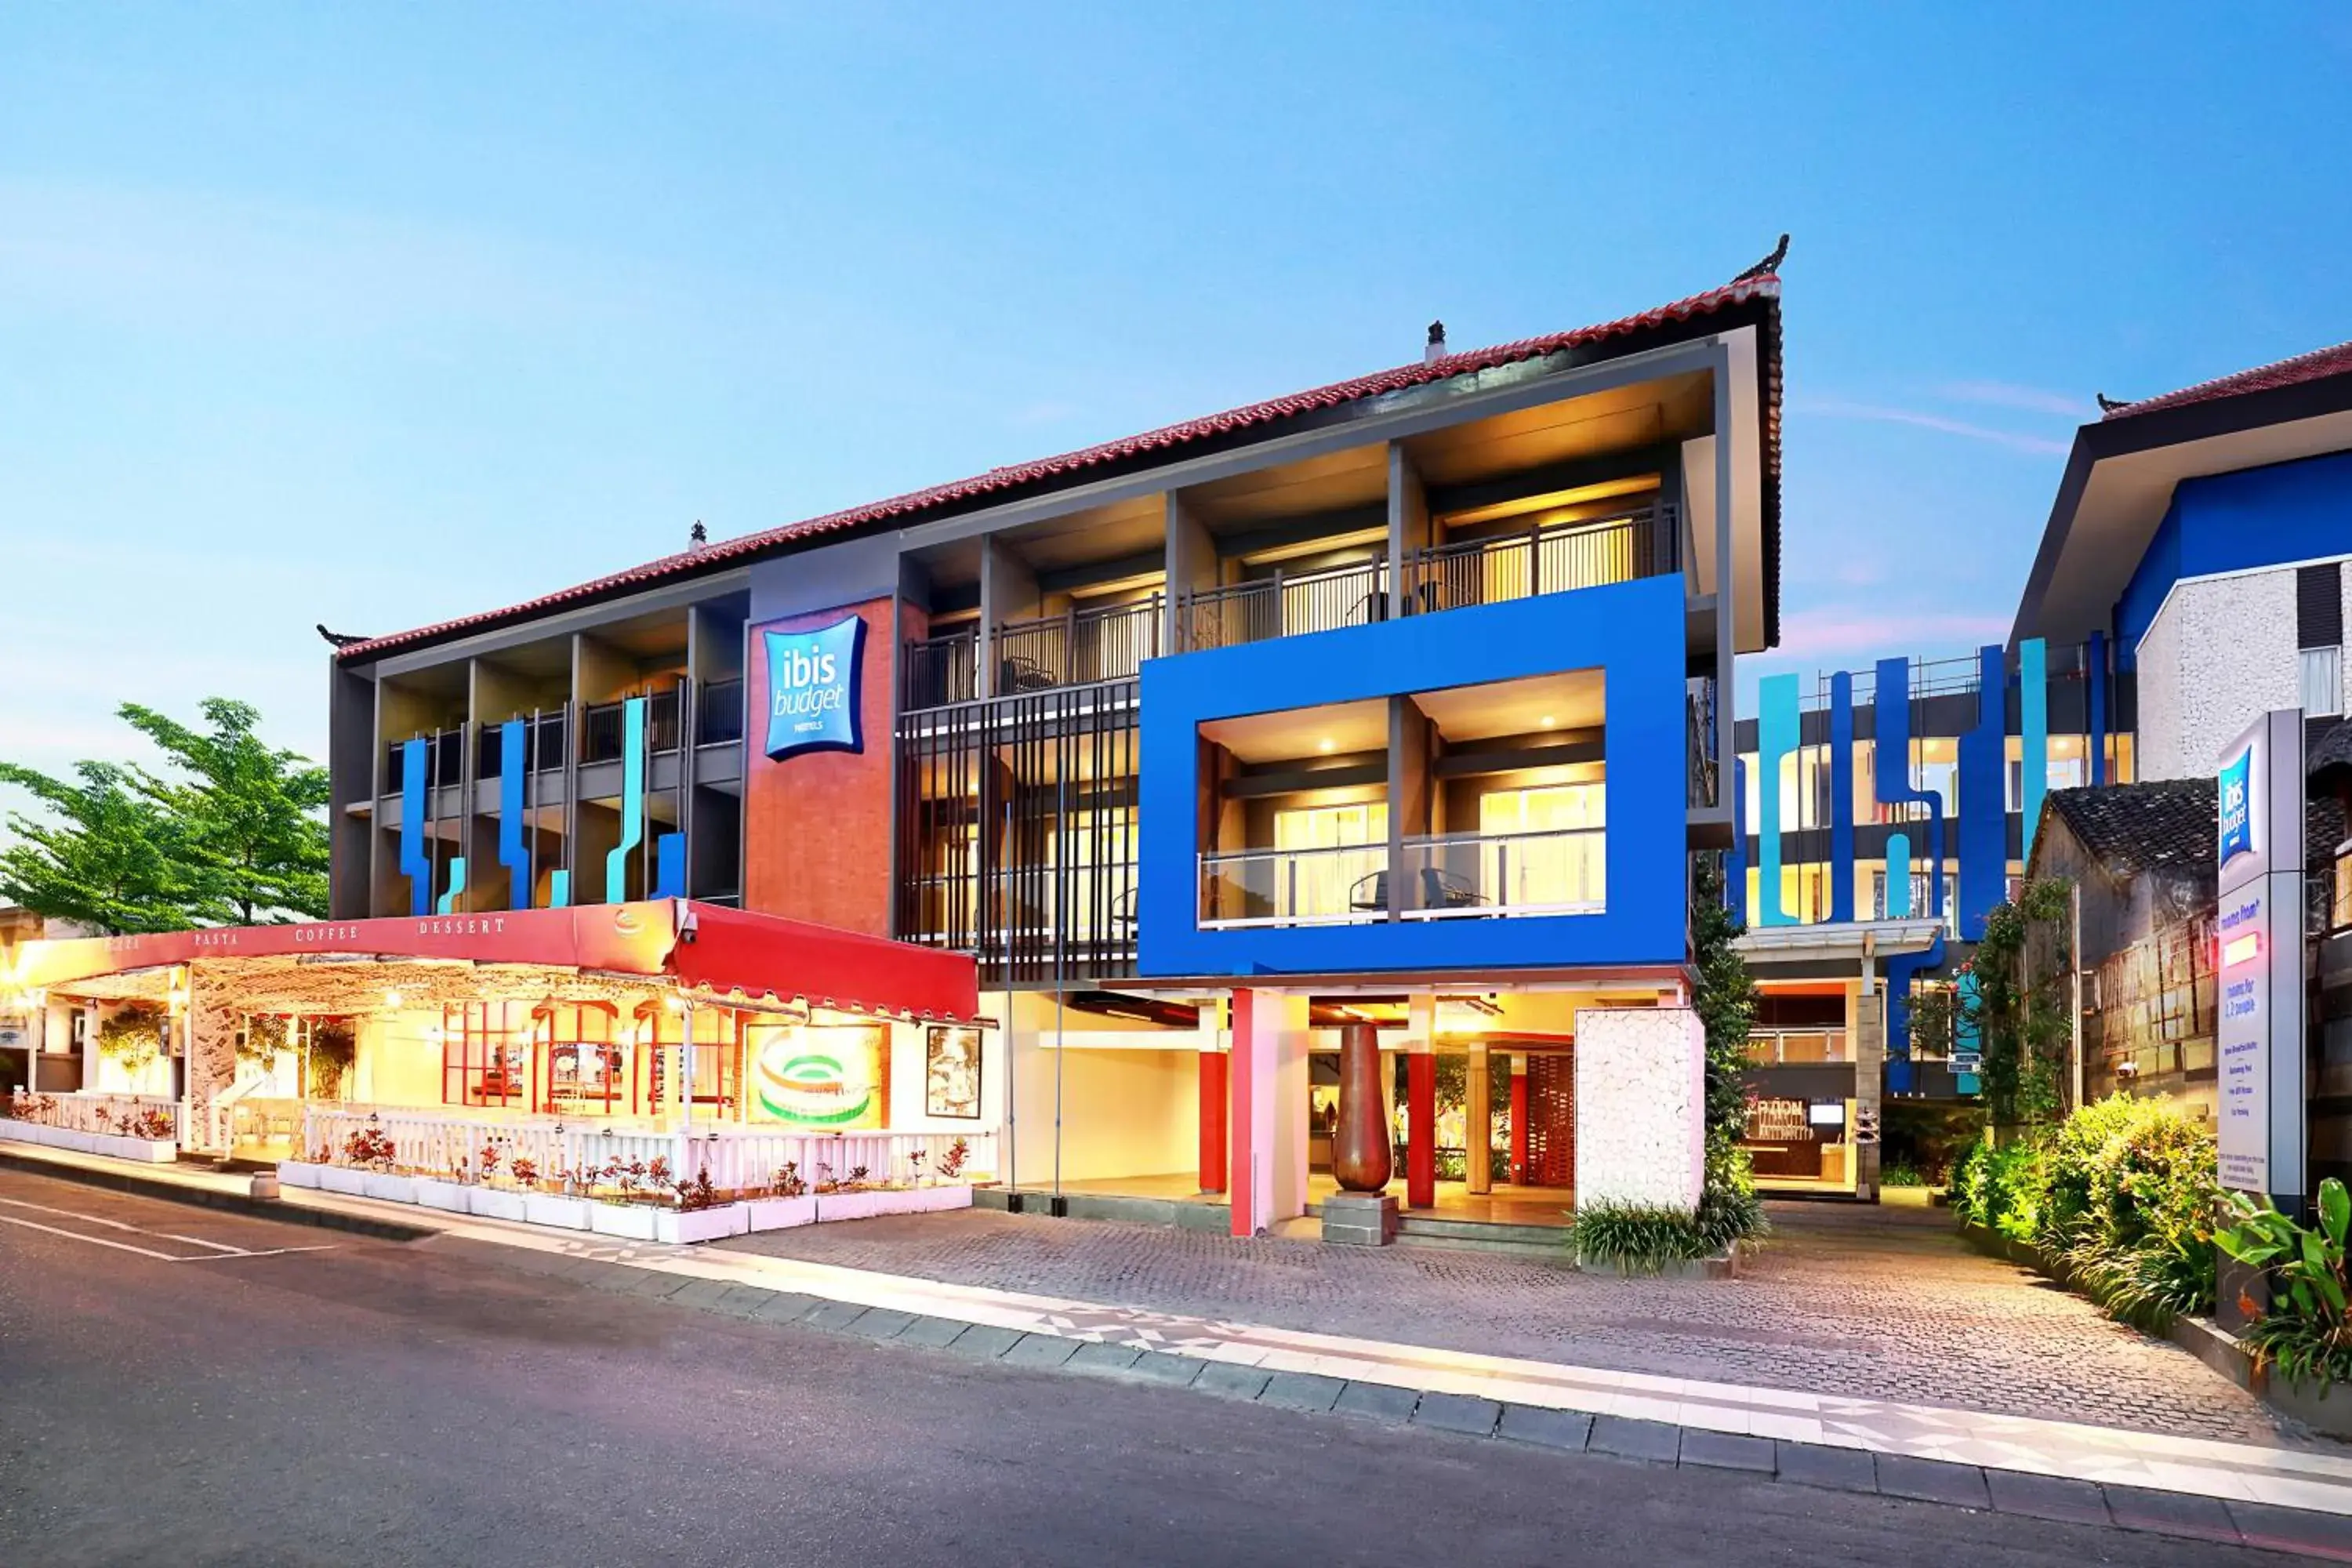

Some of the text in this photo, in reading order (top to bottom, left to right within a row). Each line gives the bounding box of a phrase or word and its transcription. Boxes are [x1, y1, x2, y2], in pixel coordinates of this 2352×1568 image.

[784, 645, 836, 689] ibis
[775, 684, 844, 717] budget
[195, 933, 238, 946] PASTA
[296, 926, 358, 942] COFFEE
[419, 918, 504, 935] DESSERT
